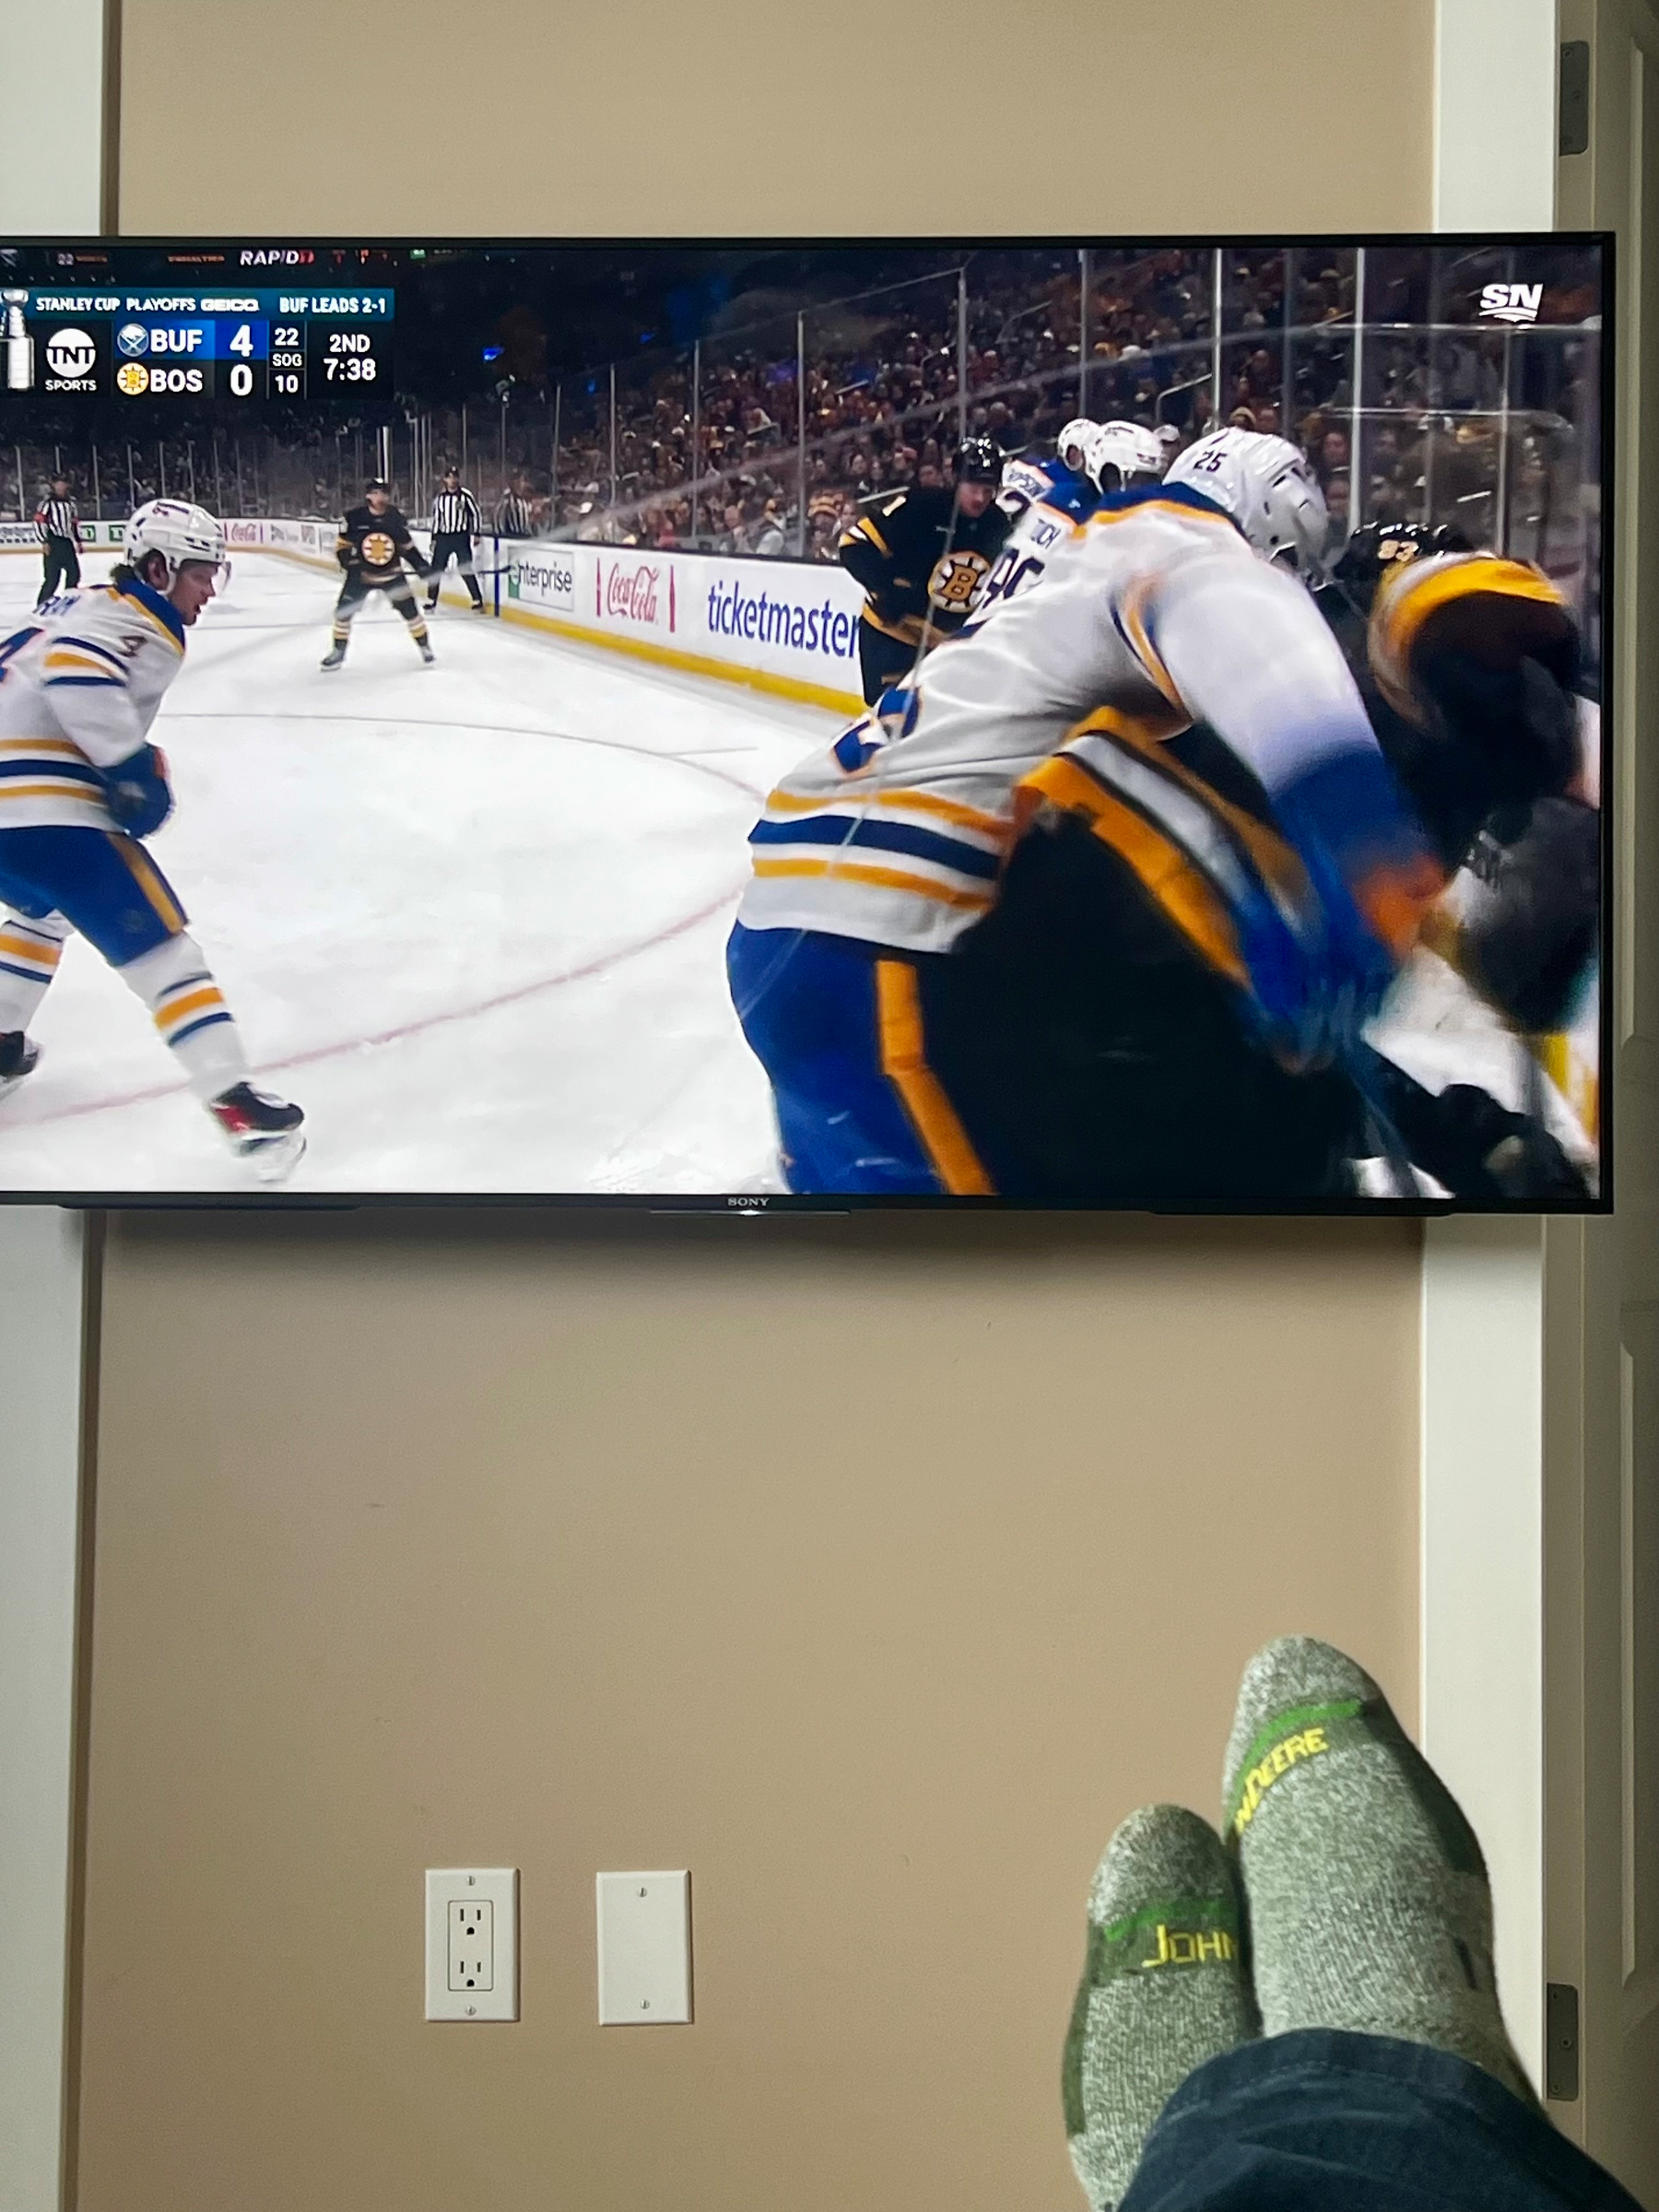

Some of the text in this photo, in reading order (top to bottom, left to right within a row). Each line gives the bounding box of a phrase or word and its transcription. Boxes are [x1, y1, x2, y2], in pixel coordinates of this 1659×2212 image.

[36, 297, 196, 312] STANLEY CUP PLAYOFFS
[200, 299, 259, 312] GEICO
[279, 297, 386, 314] BUF LEADS 2-1
[1479, 284, 1544, 312] SN
[150, 329, 203, 352] BUF
[229, 324, 253, 357] 4
[275, 328, 299, 346] 22
[329, 335, 371, 352] 2ND
[46, 342, 96, 364] TNT
[272, 354, 302, 367] SOG
[150, 369, 203, 392] BOS
[230, 364, 253, 395] 0
[324, 358, 376, 381] 7:38
[45, 380, 97, 391] SPORTS
[275, 375, 299, 393] 10
[1193, 450, 1228, 473] 25
[708, 580, 861, 659] ticketmaster
[727, 1197, 770, 1206] SONY
[1245, 1727, 1329, 1809] DEERE
